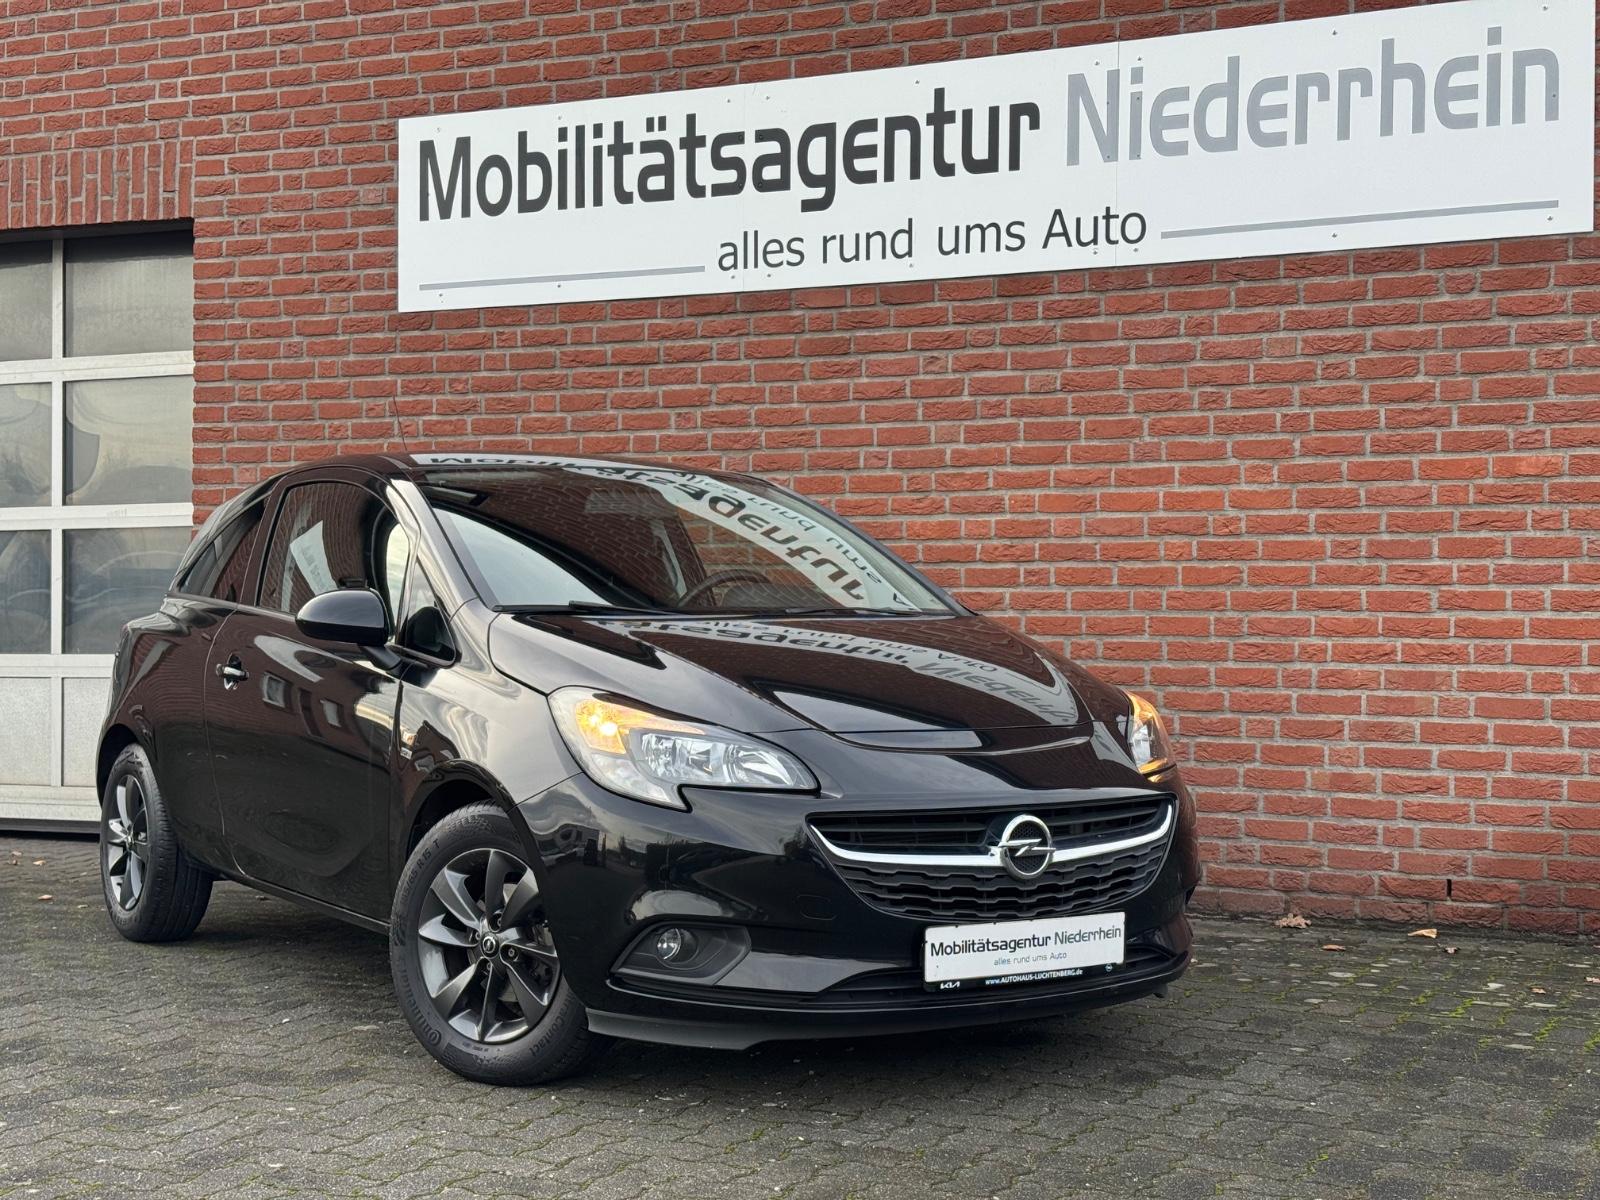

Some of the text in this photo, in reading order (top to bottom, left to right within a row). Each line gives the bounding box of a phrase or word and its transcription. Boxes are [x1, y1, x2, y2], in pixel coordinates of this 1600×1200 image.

[420, 26, 1560, 221] Mobilitätsagentur Niederrhein
[718, 206, 1147, 272] alles rund ums Auto
[930, 925, 1121, 957] Mobilitätsagentur Niederrhein
[993, 951, 1067, 966] alles rund ums Auto
[985, 968, 1083, 985] www.AUTOHAUS-LUCHTENBERG.de
